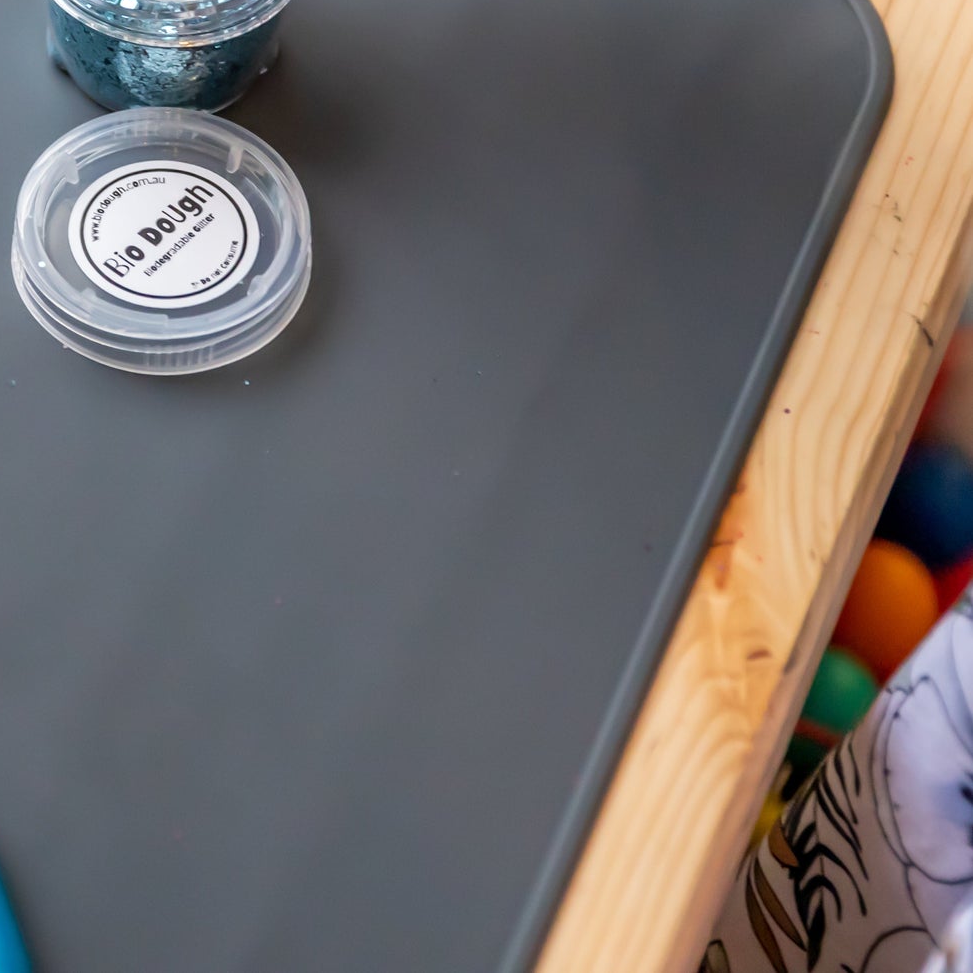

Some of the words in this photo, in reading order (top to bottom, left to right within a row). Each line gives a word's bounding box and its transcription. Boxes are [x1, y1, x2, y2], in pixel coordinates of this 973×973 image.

[91, 176, 166, 242] www.biodough.com.au
[103, 245, 145, 279] Bio
[144, 231, 196, 277] Biodegradable
[193, 213, 215, 232] Glitter
[200, 277, 212, 285] Do
